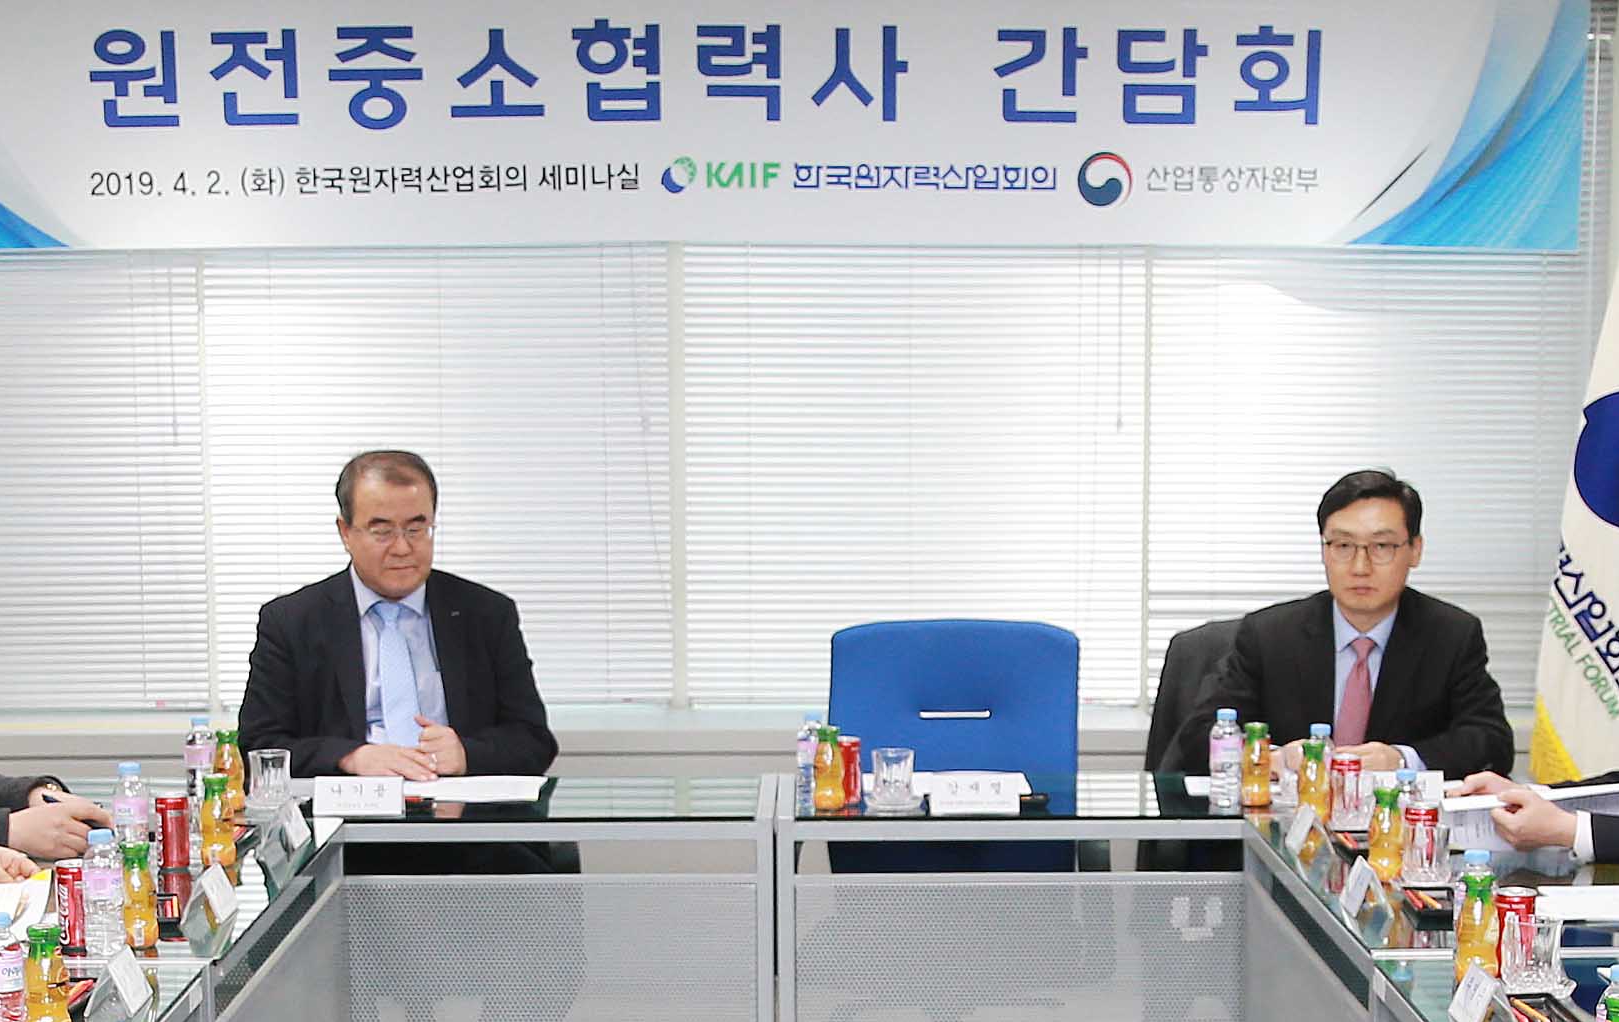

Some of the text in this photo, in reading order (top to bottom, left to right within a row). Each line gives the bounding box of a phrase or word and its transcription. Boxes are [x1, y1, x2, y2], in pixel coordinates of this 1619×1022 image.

[88, 18, 1322, 130] 원전중소협력사 간담회
[90, 162, 639, 196] 2019. 4. 2. (화) 한국원자력산업회의 세미나실
[705, 161, 781, 189] KAIF
[792, 161, 1058, 192] 한국원자력산업회의
[1146, 165, 1319, 193] 산업통상자원부
[1548, 602, 1581, 657] TRIAL
